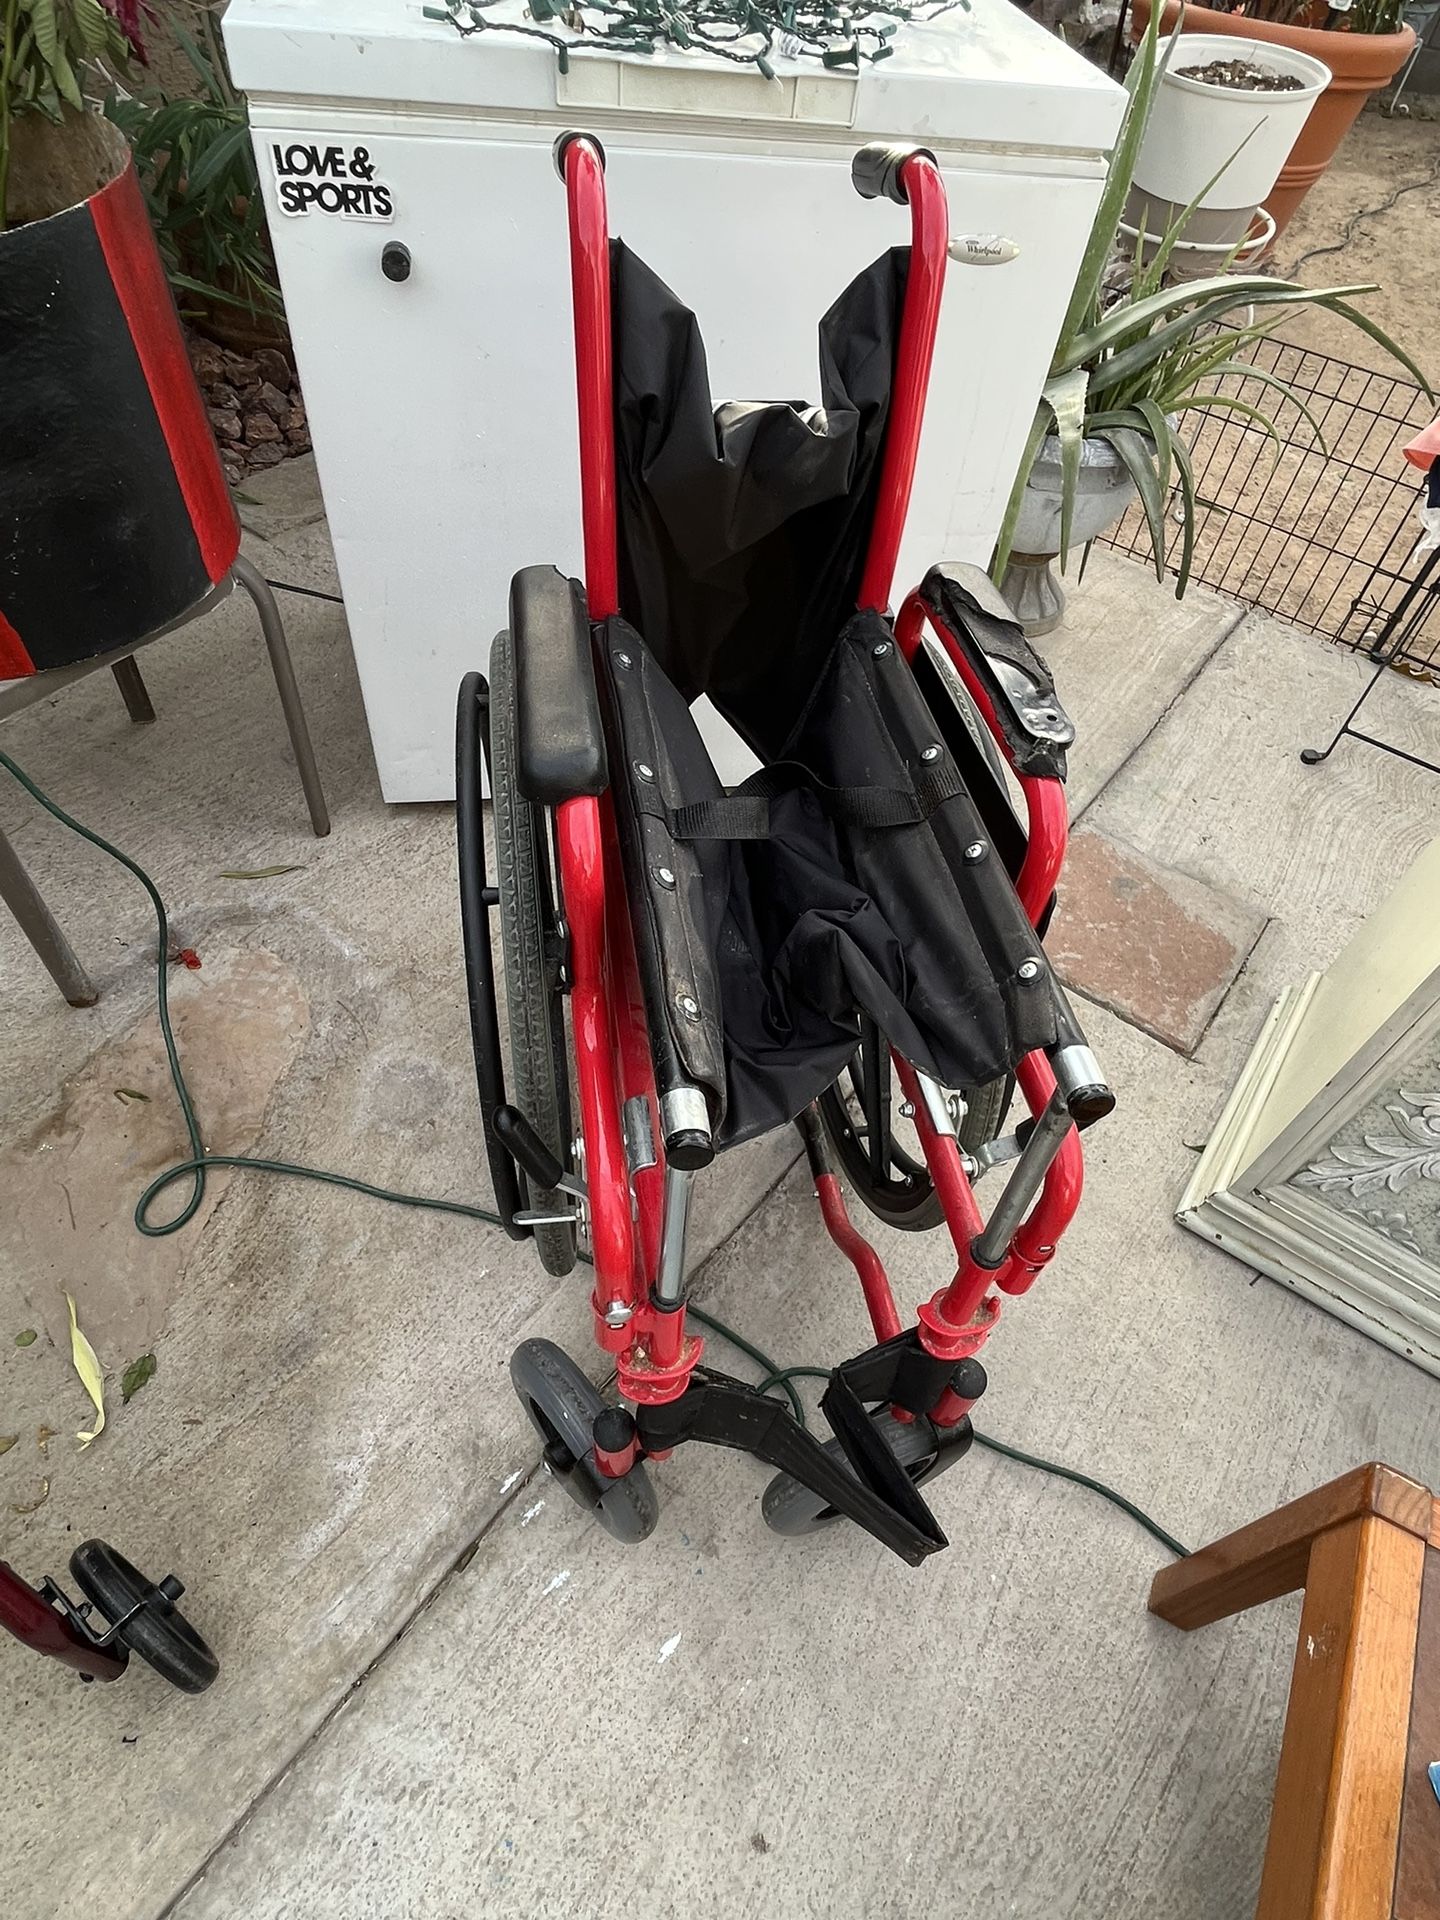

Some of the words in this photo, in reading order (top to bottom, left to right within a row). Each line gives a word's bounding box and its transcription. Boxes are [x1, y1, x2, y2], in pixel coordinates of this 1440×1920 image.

[272, 144, 347, 178] LOVE
[349, 146, 376, 182] &
[280, 181, 392, 216] SPORTS
[967, 245, 1002, 256] Whirlpool
